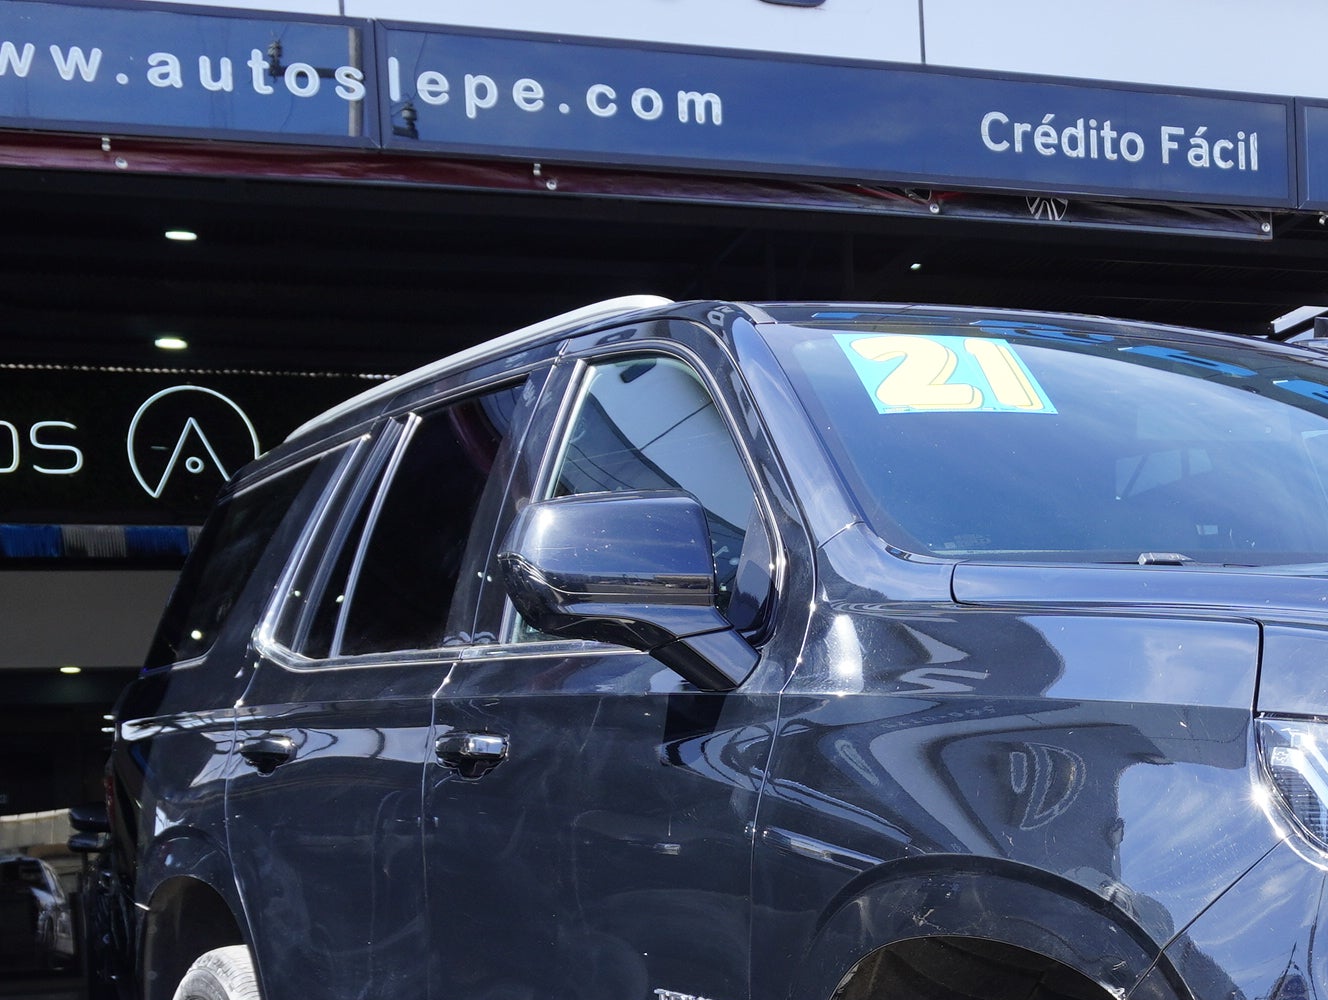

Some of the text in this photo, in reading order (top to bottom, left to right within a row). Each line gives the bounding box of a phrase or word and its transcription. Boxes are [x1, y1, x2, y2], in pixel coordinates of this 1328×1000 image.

[979, 110, 1260, 172] Crédito Fácil
[849, 334, 1046, 410] 21
